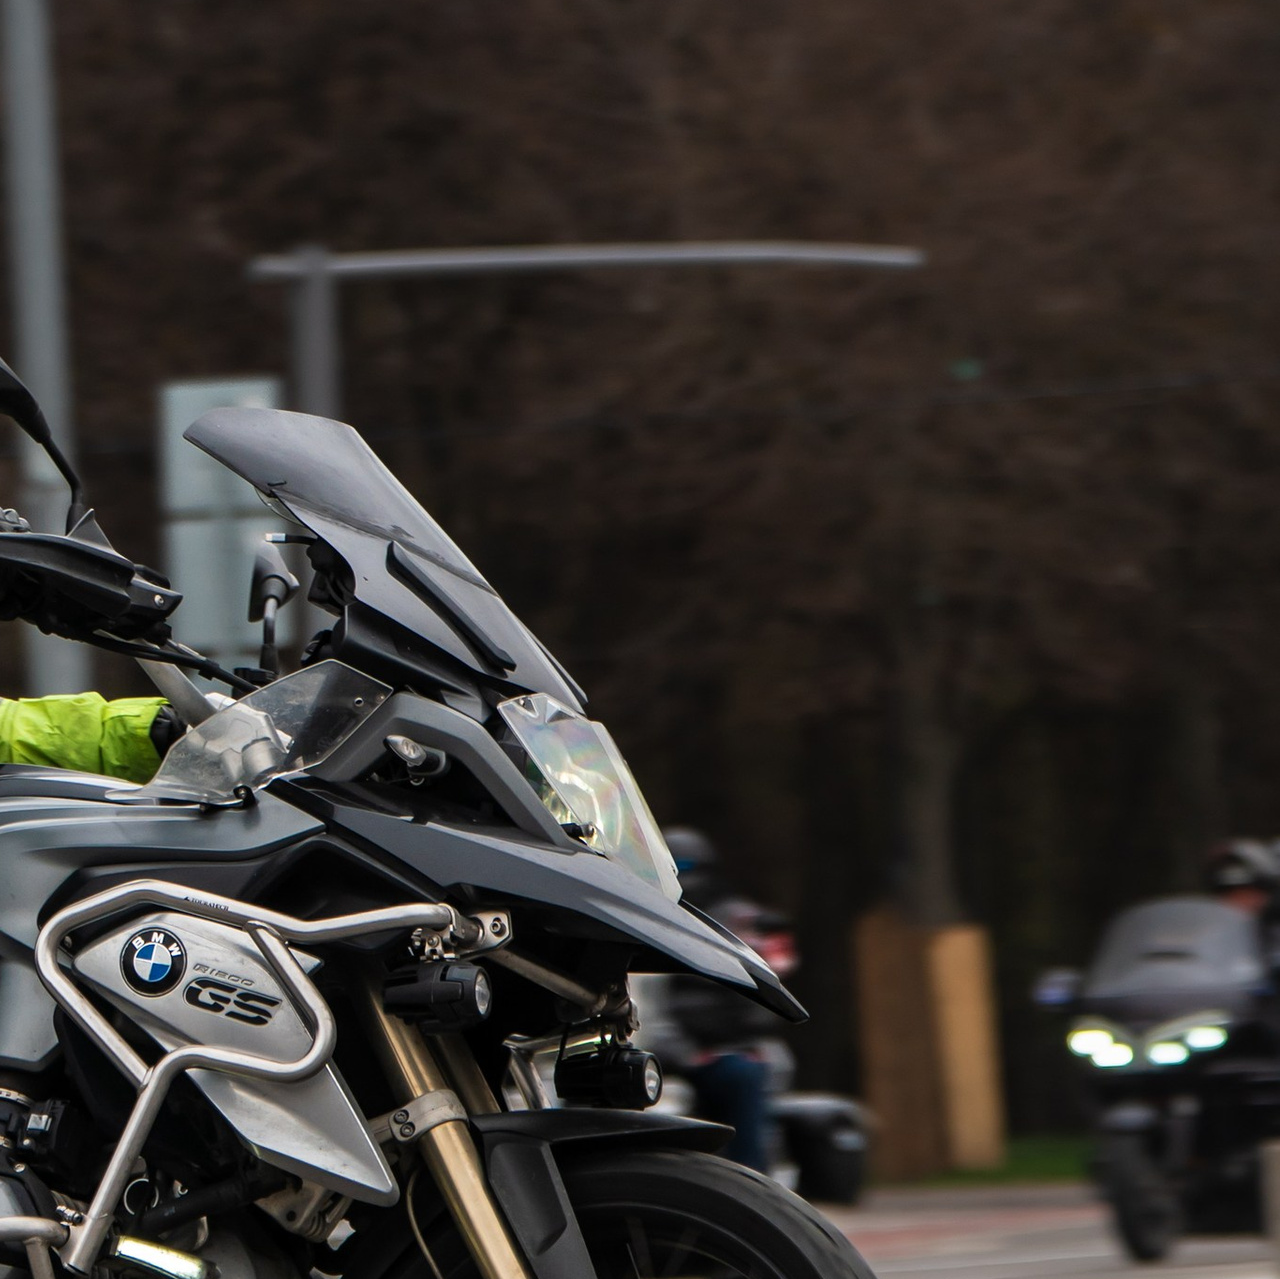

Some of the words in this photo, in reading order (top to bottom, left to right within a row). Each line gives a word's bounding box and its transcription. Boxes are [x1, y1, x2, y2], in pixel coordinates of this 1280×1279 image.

[191, 897, 230, 912] TOURATECH
[132, 932, 181, 958] BMW
[192, 962, 255, 987] R1200
[185, 979, 281, 1025] GS
